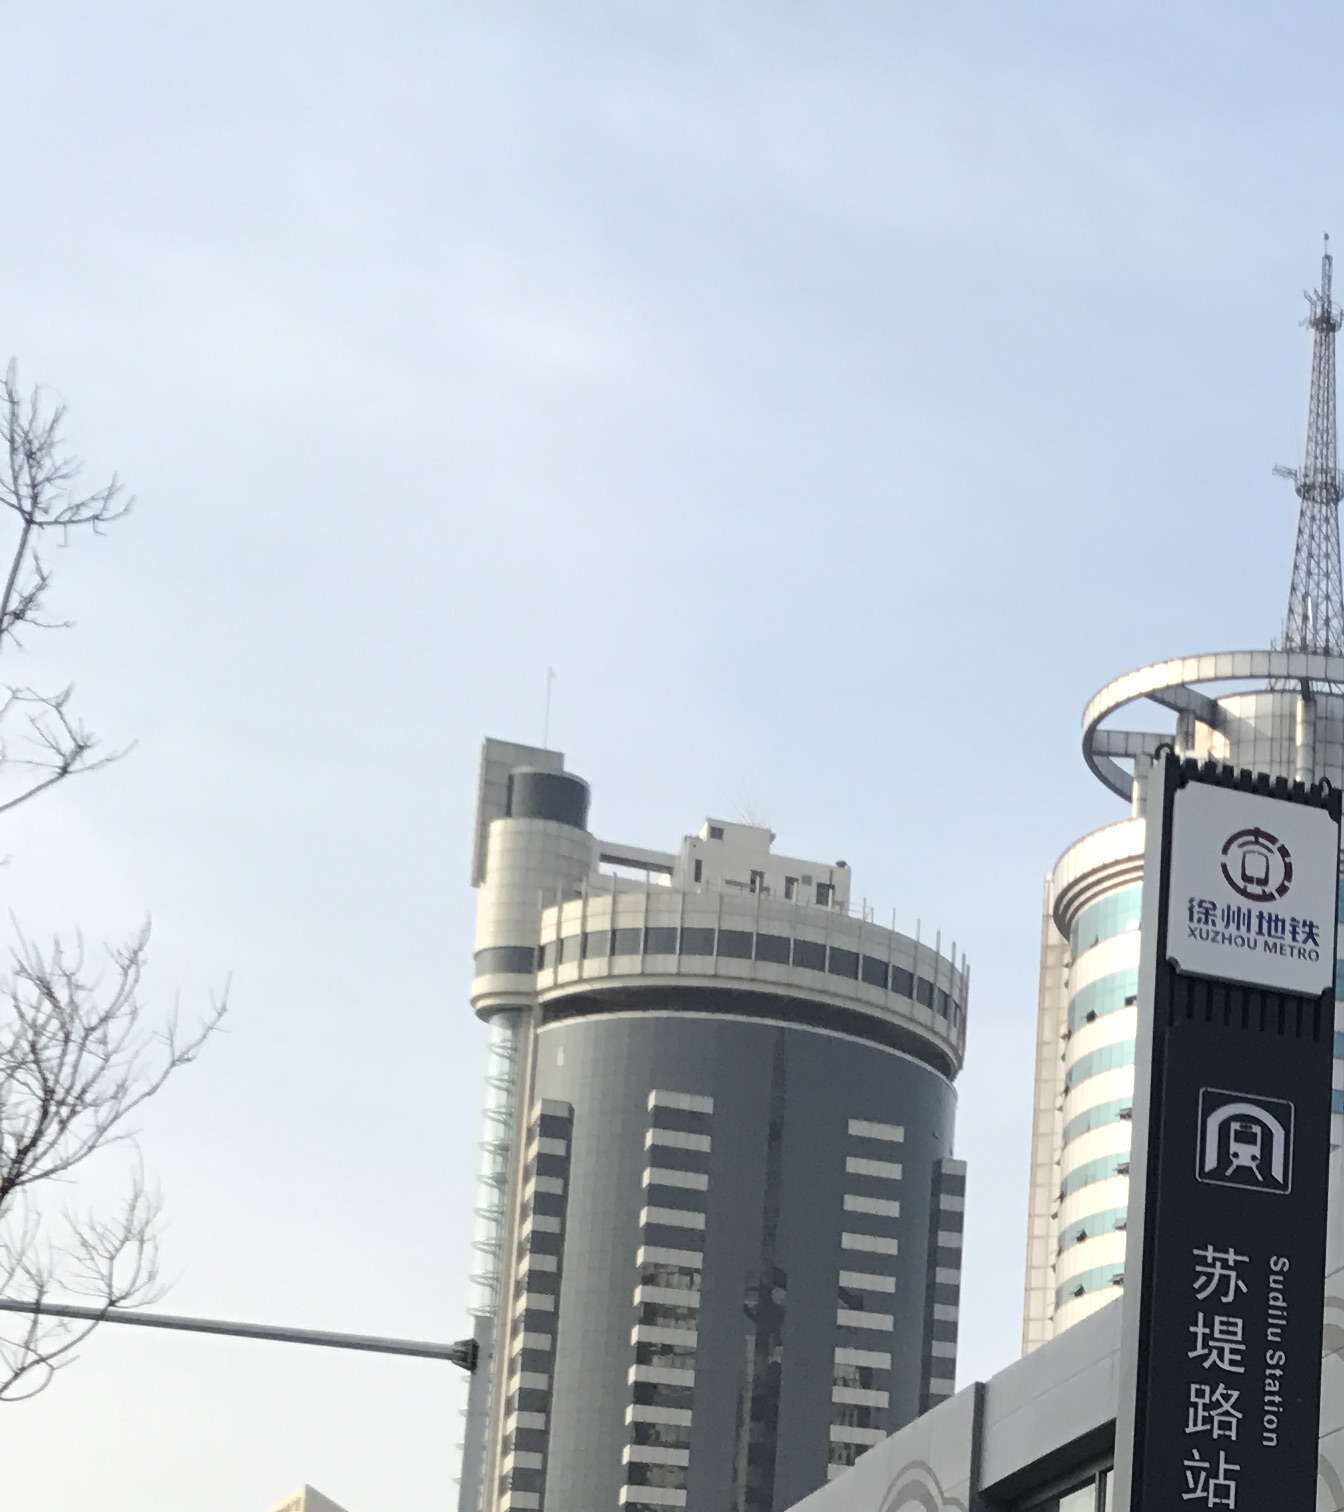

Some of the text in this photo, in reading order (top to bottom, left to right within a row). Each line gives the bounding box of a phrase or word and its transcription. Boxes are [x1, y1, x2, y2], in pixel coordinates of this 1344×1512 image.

[1187, 896, 1320, 948] 徐州地铁
[1187, 925, 1320, 963] XUZHOU METRO
[1181, 1244, 1250, 1510] 苏堤路站
[1262, 1255, 1290, 1447] Sudilu Station
